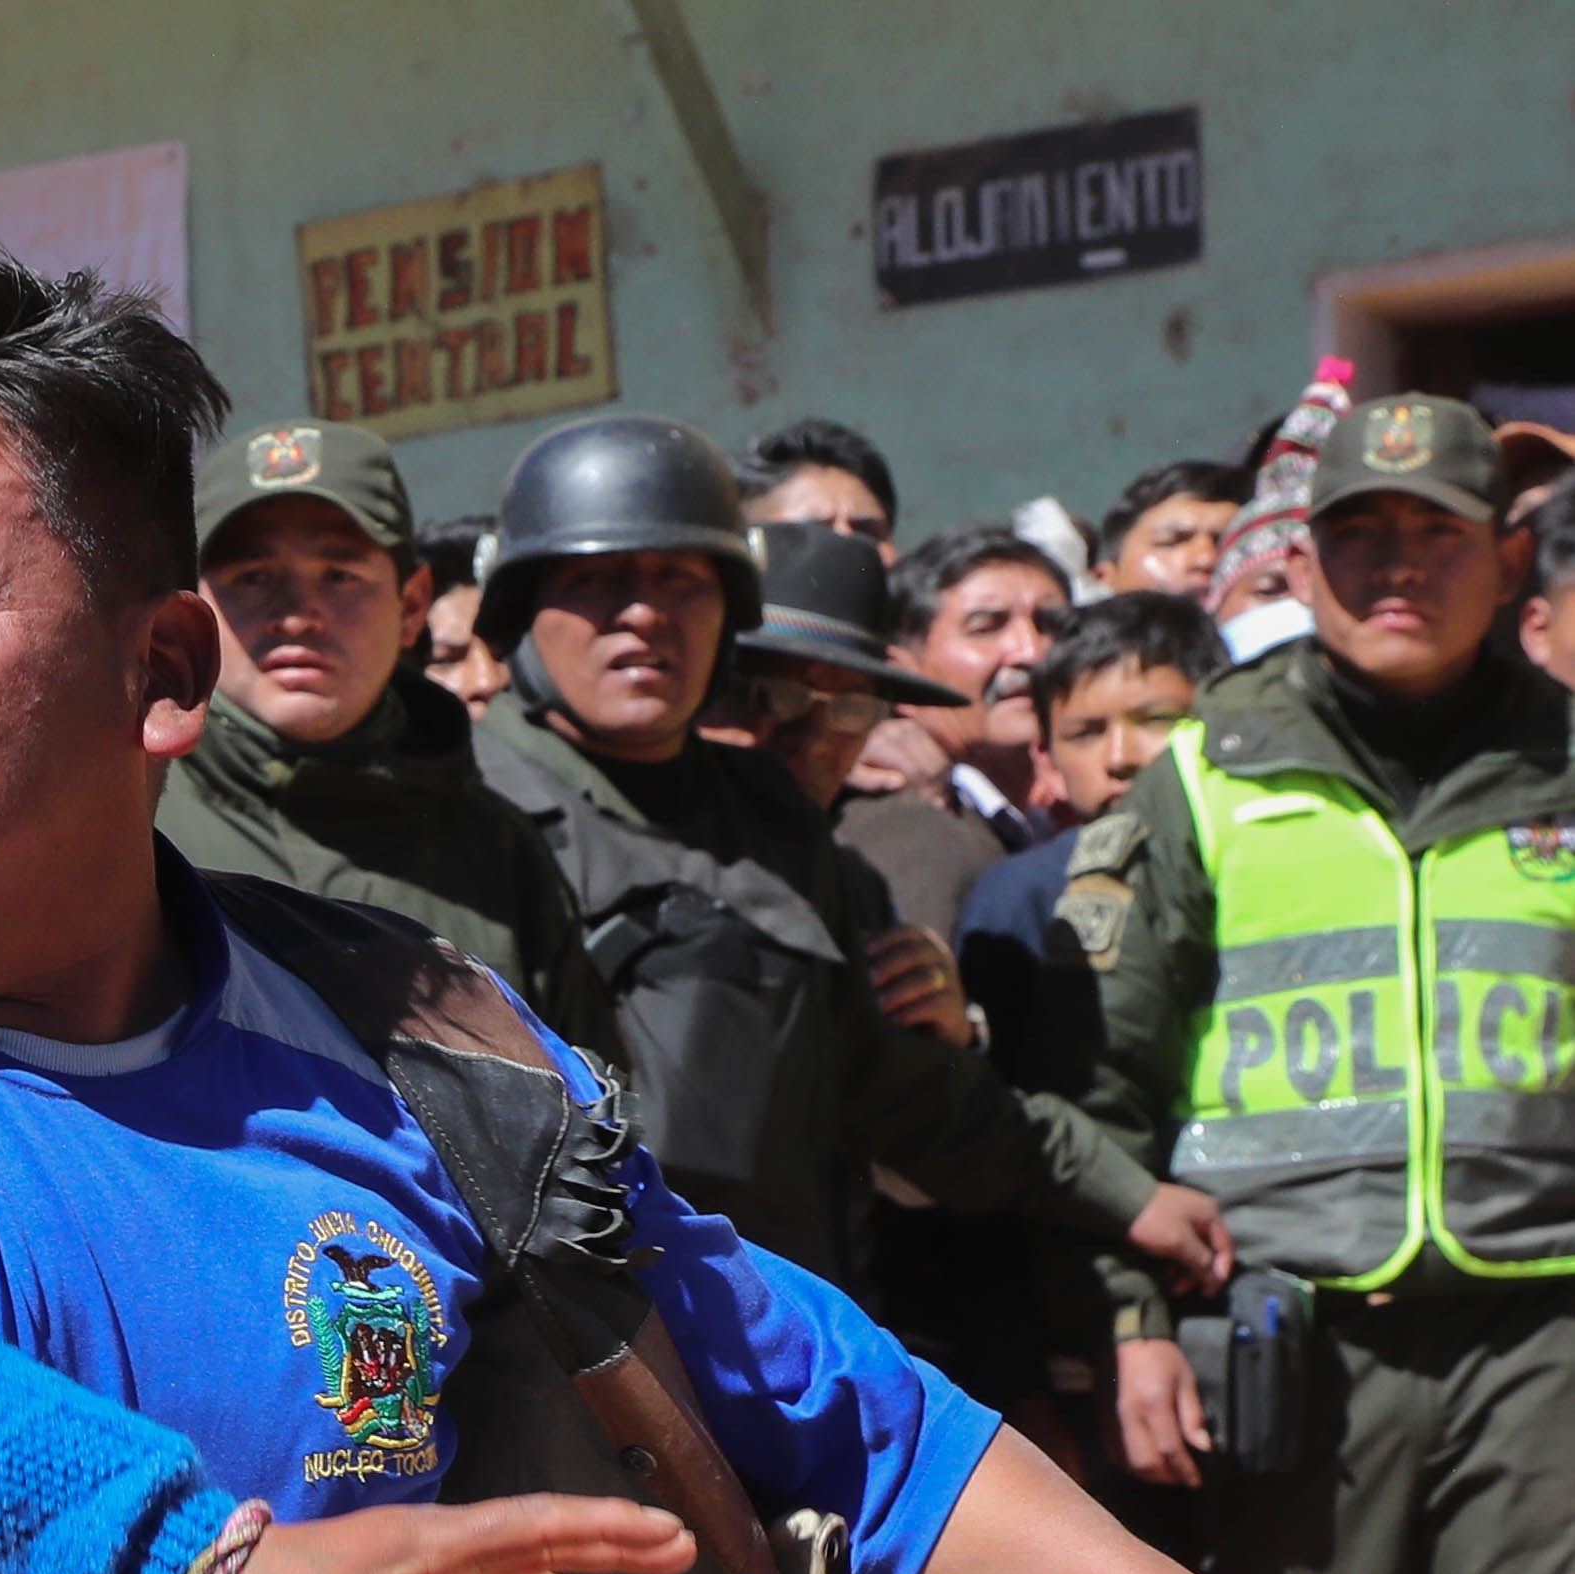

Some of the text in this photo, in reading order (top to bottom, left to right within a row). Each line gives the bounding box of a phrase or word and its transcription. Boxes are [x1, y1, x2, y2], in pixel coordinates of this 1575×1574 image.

[875, 149, 1199, 271] ALOJAMIENTO
[309, 205, 593, 340] PENSION
[319, 301, 593, 423] CENTRAL
[284, 1241, 317, 1348] DISTRITO
[304, 1449, 385, 1482] NUCLEO
